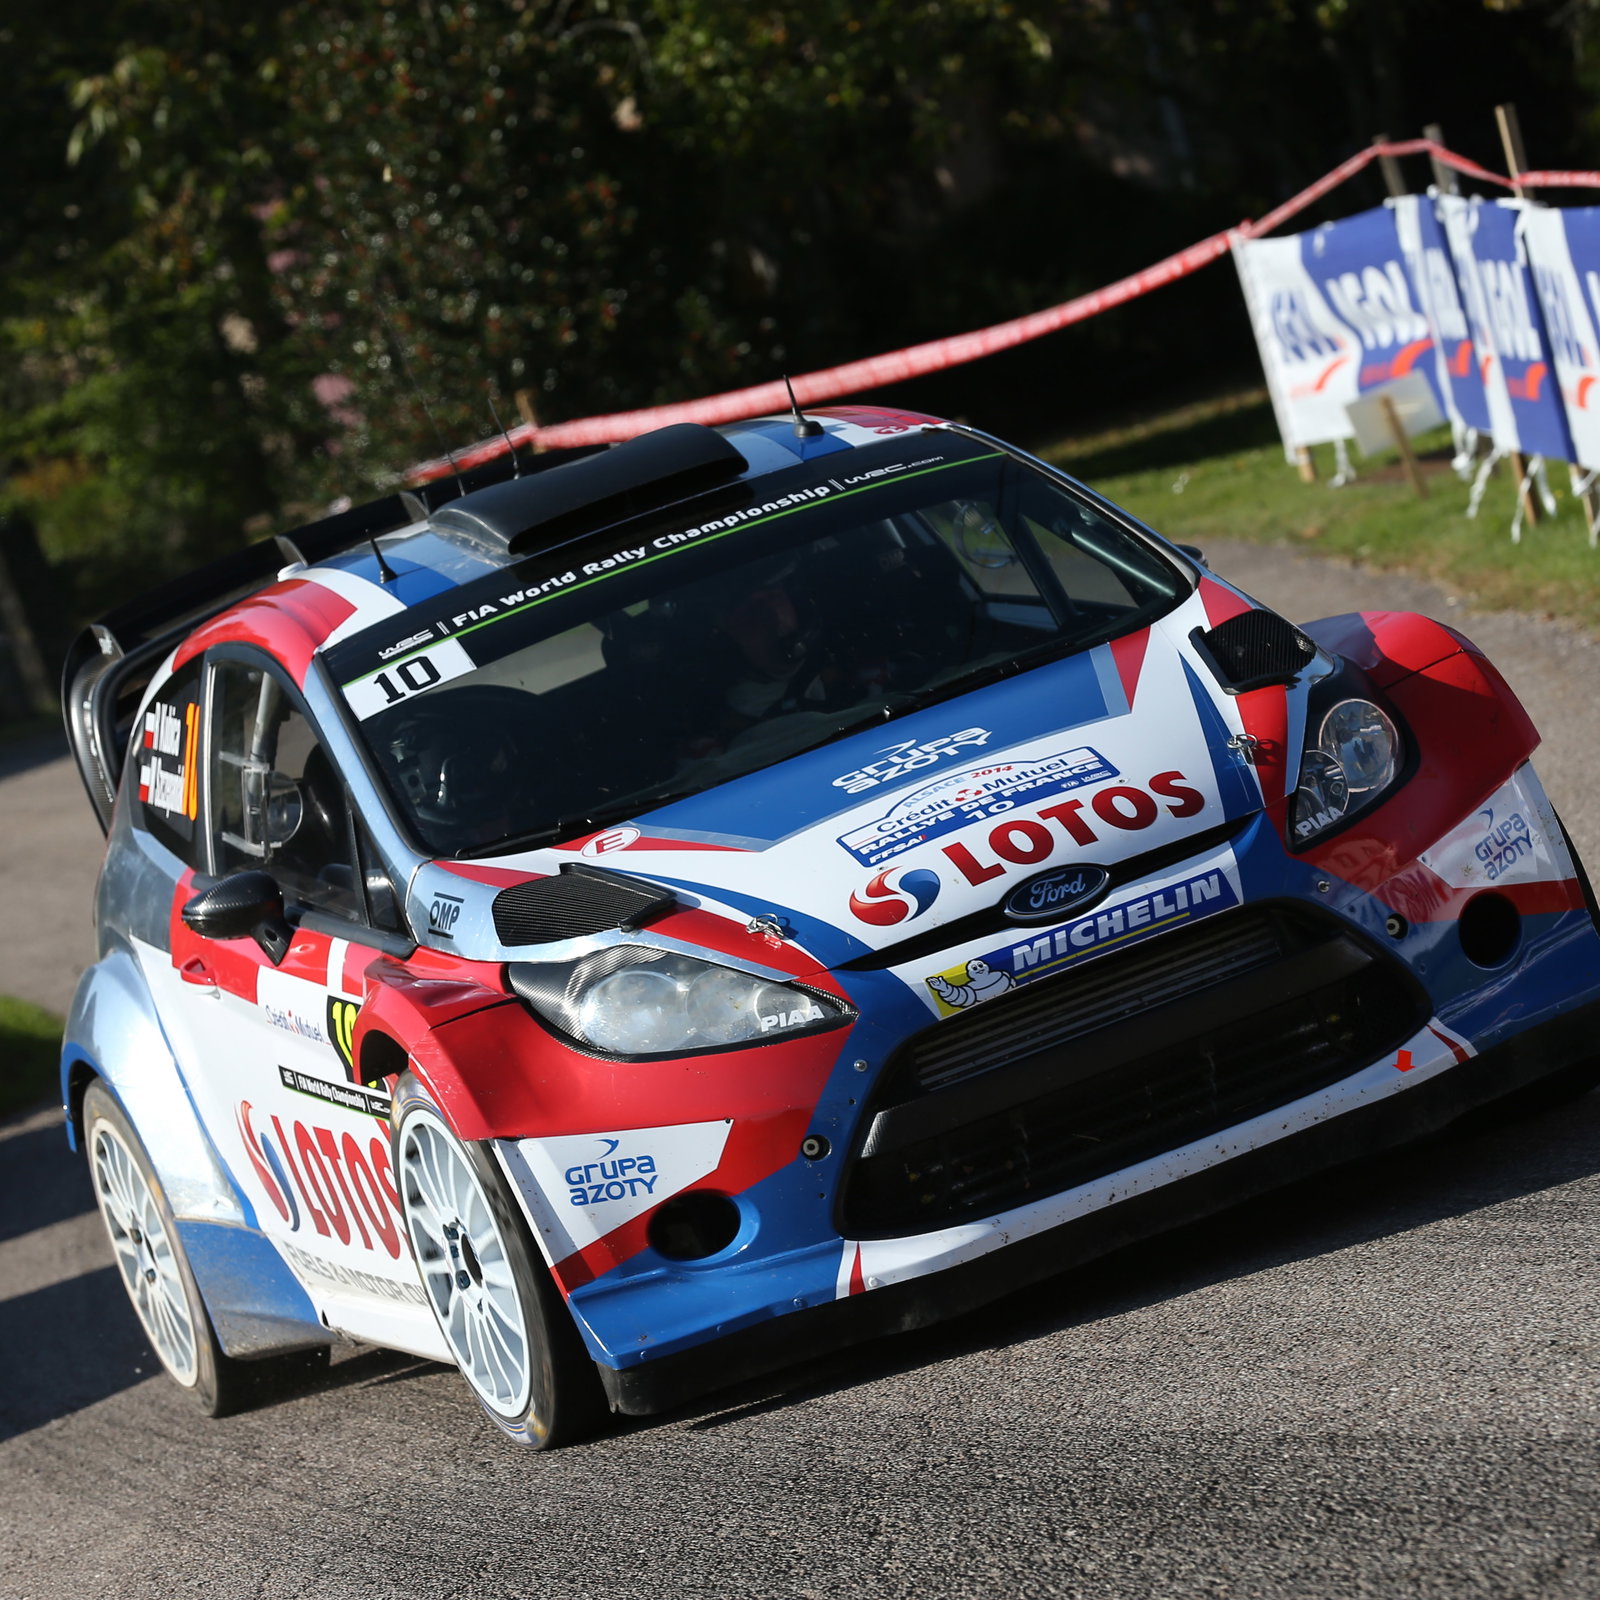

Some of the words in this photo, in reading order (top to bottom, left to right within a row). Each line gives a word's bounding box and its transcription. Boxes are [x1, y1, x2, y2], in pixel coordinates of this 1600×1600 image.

[452, 604, 498, 627] FIA
[499, 571, 577, 607] World
[582, 546, 647, 576] Rally
[652, 485, 831, 549] Championship
[374, 656, 441, 704] 10
[877, 799, 953, 832] Crédit
[982, 759, 1068, 792] Mutuel
[903, 776, 966, 808] ALSACE
[970, 765, 1014, 779] 2014
[859, 810, 956, 855] RALLYE
[960, 795, 997, 812] DE
[1000, 761, 1103, 797] FRANCE
[941, 771, 1205, 886] LOTOS
[964, 800, 1016, 821] 10
[1295, 806, 1344, 837] PIAA
[869, 837, 921, 864] FFSA
[1029, 873, 1087, 909] Ford
[429, 900, 461, 931] OMP
[1012, 873, 1222, 972] MICHELIN
[760, 1005, 825, 1033] PIAA
[338, 1265, 412, 1304] MOTOR
[402, 1282, 429, 1306] OI
